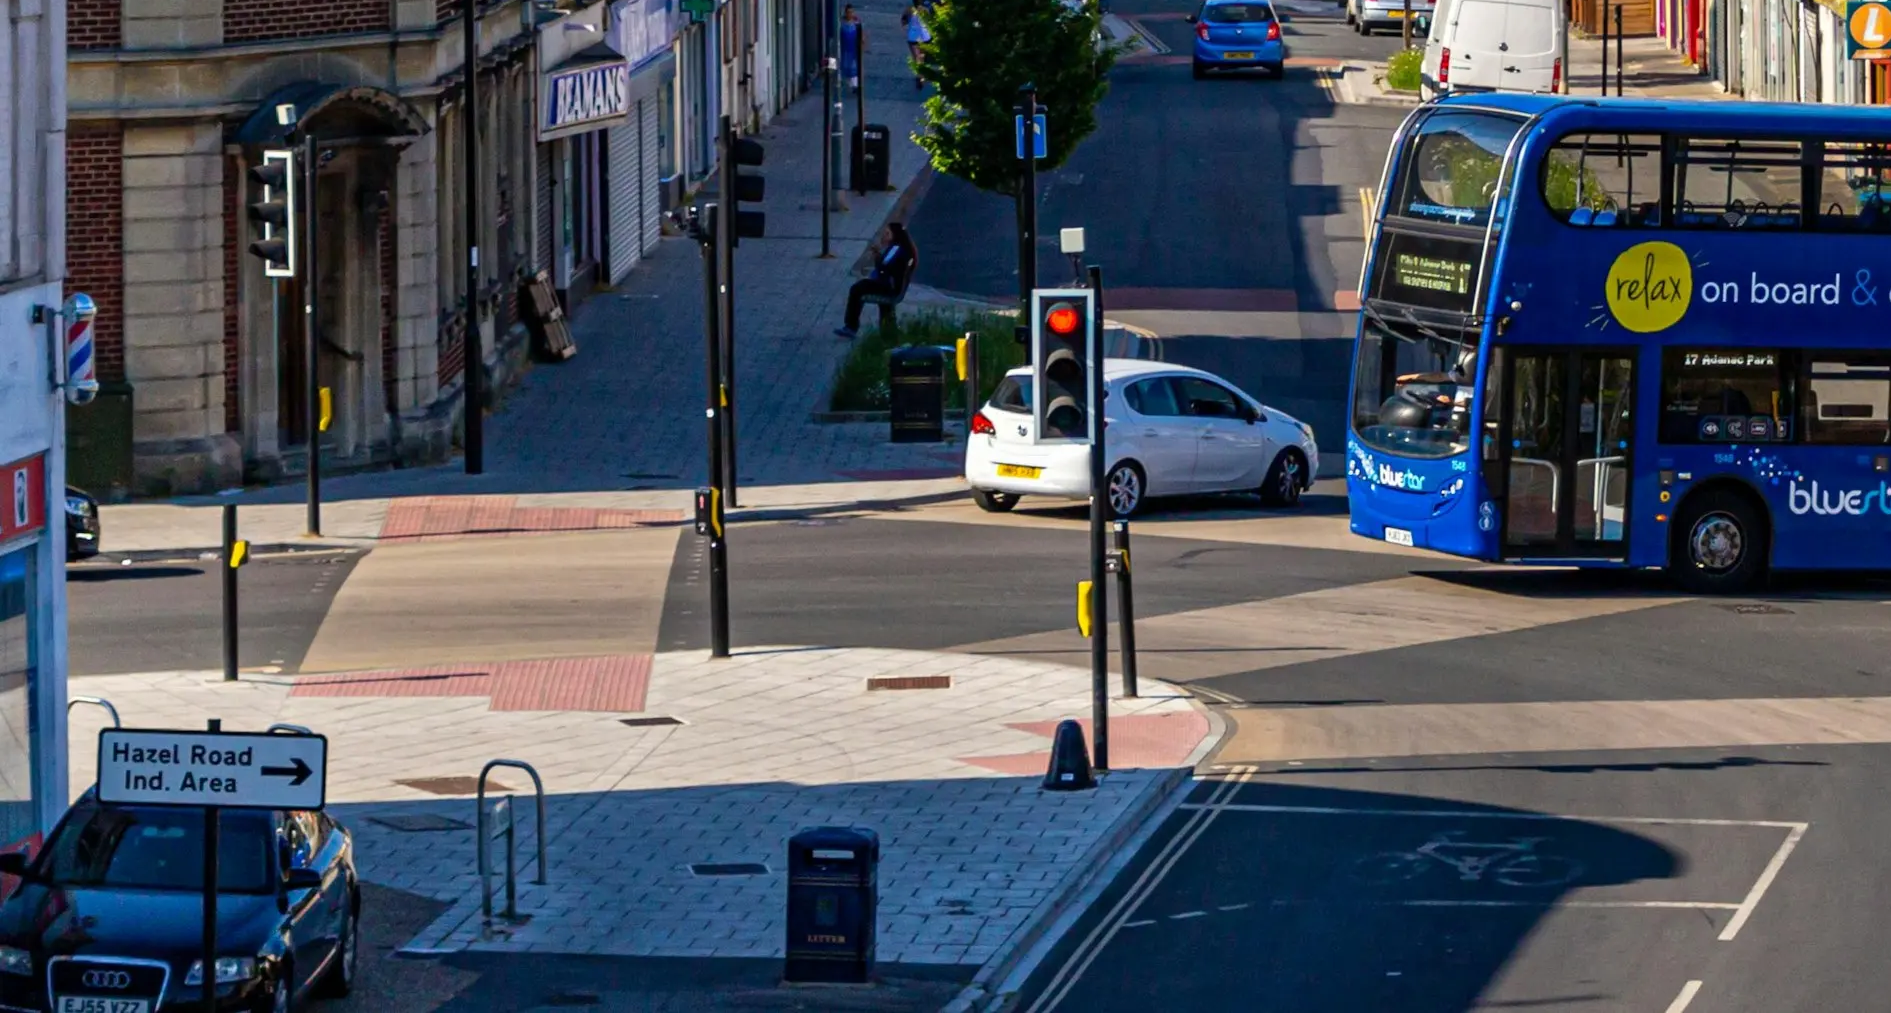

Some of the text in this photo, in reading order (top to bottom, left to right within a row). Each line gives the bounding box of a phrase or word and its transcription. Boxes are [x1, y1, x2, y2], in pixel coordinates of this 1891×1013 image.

[1863, 7, 1884, 42] L
[557, 66, 626, 127] BEAMANS
[1615, 252, 1683, 311] relax
[1702, 282, 1739, 303] on
[1751, 272, 1840, 306] board
[1852, 268, 1878, 306] &
[1746, 354, 1774, 366] Park
[1380, 463, 1425, 490] bluestar
[112, 742, 254, 767] Hazel Road
[125, 769, 238, 794] Ind. Area
[65, 997, 106, 1013] EJ55
